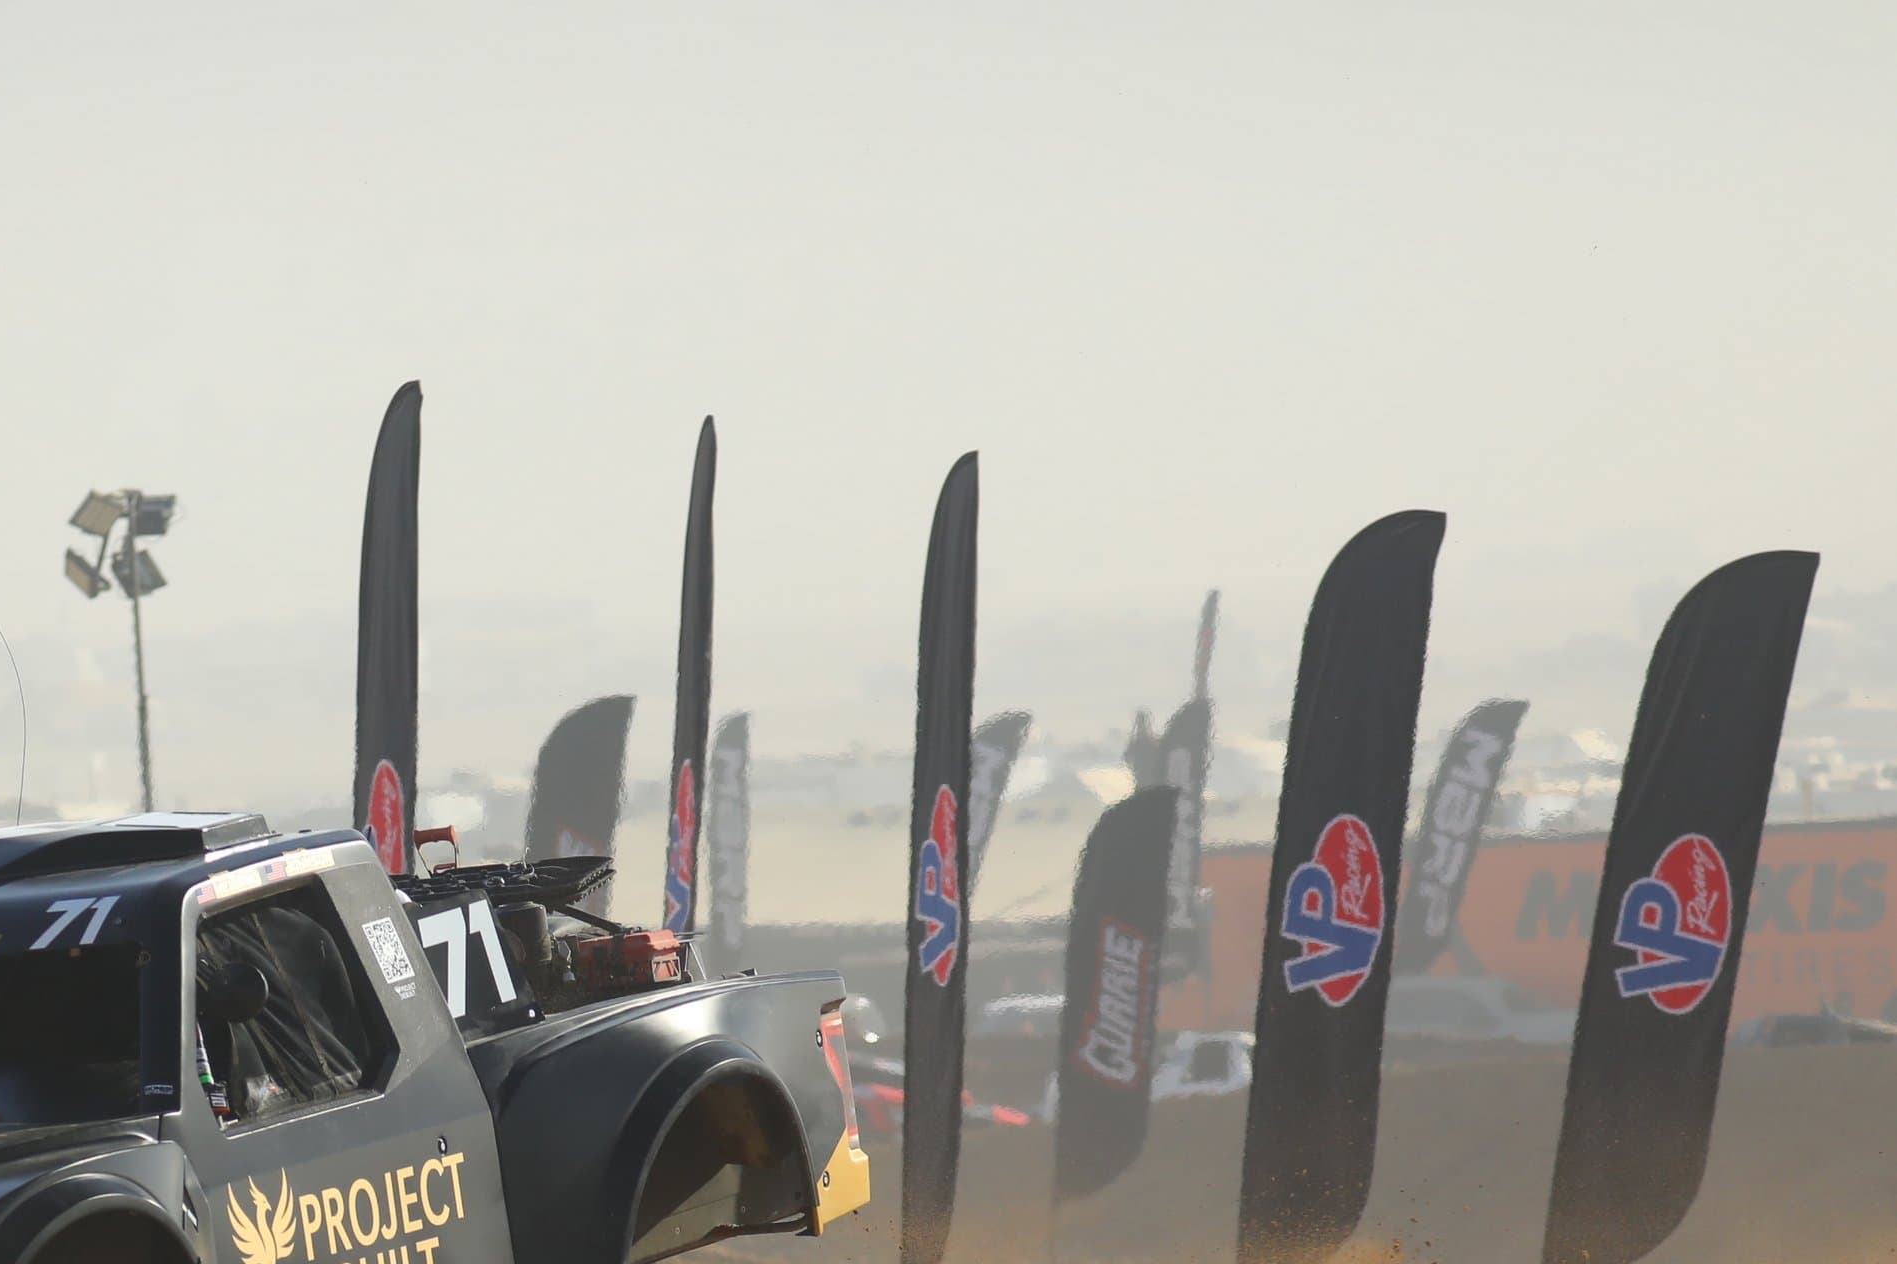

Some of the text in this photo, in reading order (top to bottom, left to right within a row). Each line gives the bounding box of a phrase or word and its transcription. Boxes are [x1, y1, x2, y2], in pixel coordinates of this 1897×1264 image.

[28, 895, 120, 950] 71
[418, 899, 517, 1018] 71
[914, 838, 961, 972] VP
[1280, 862, 1382, 993] VP
[1614, 877, 1727, 998] VP
[299, 1152, 465, 1262] PROJECT
